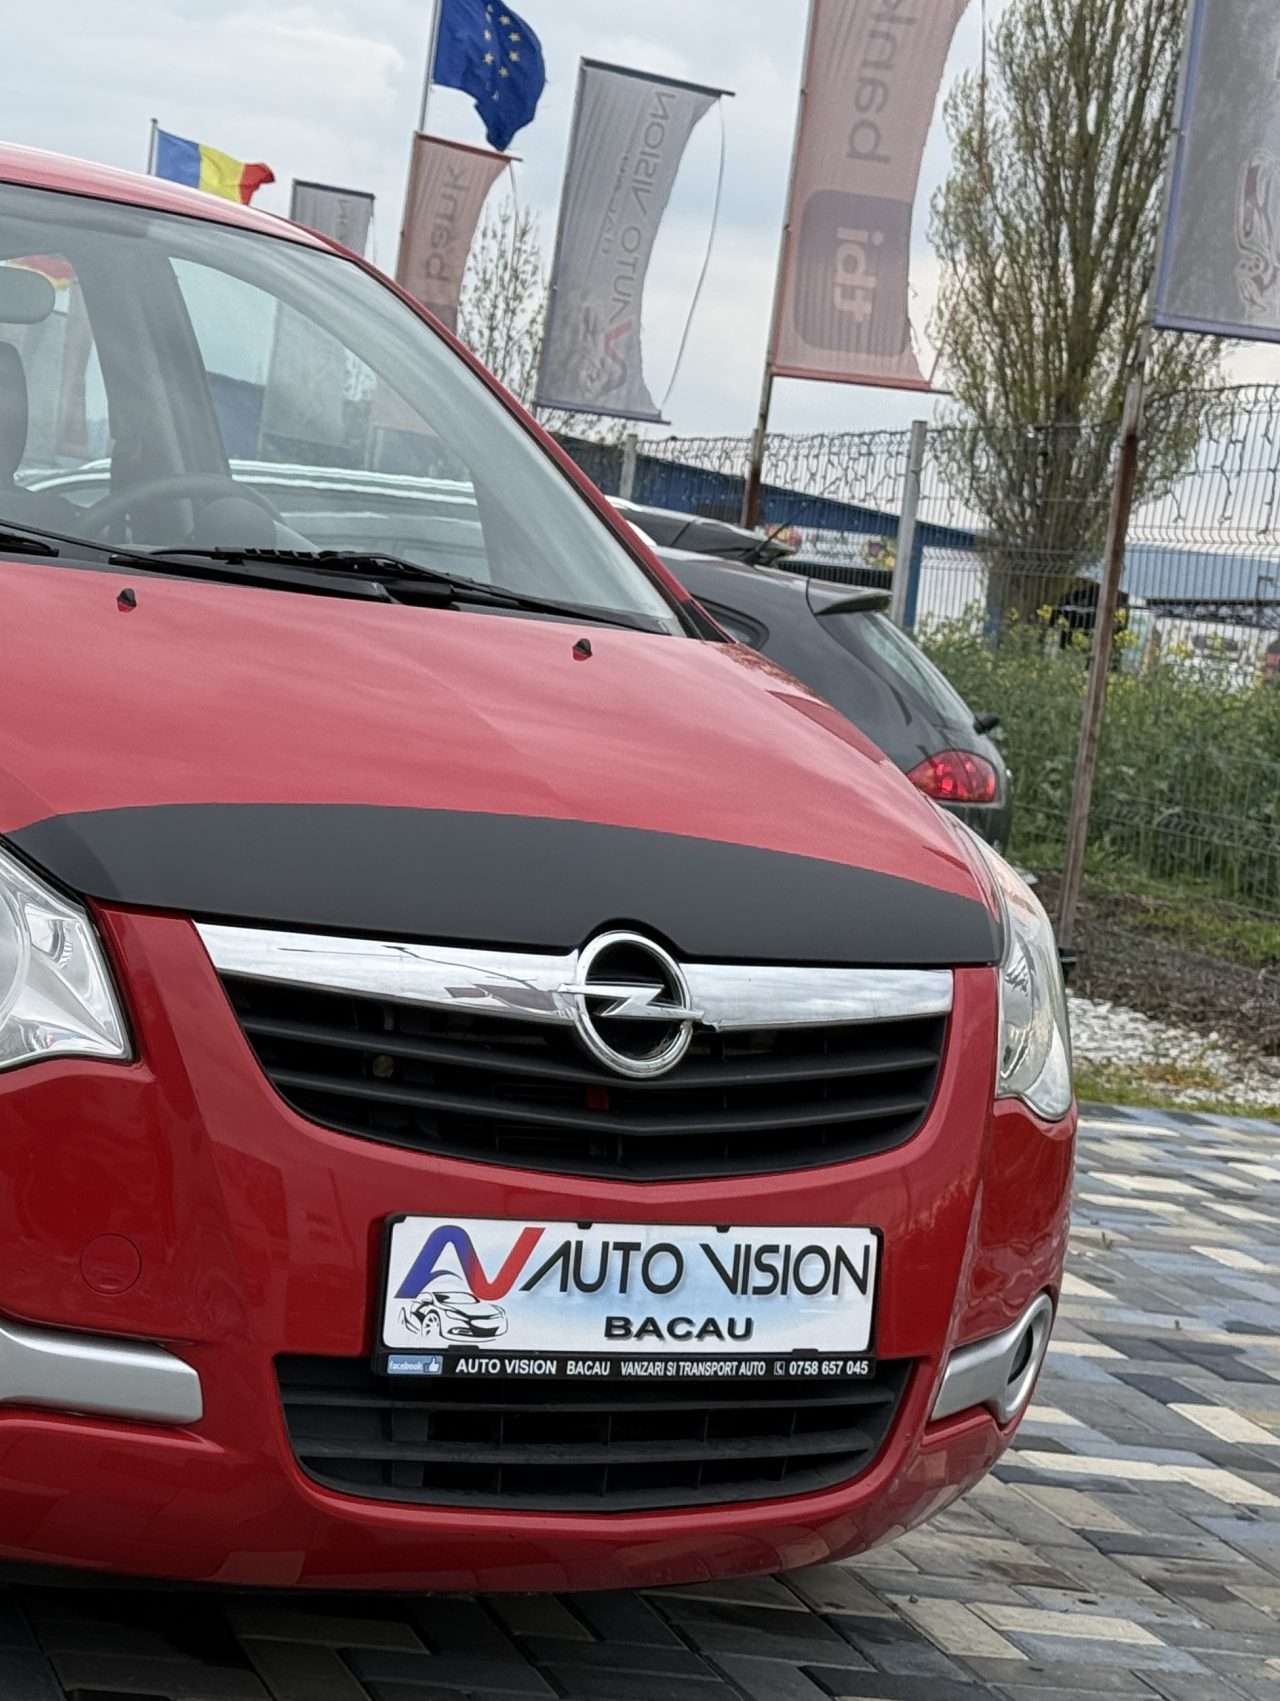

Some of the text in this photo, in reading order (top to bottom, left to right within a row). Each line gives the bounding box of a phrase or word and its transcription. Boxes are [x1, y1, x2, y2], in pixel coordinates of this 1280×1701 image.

[520, 1240, 871, 1297] AUTO VISION
[603, 1316, 754, 1342] BACAU
[455, 1358, 869, 1376] AUTO VISION BACAU VANZARI SI TRANSPORT AUTO 0758 657 045
